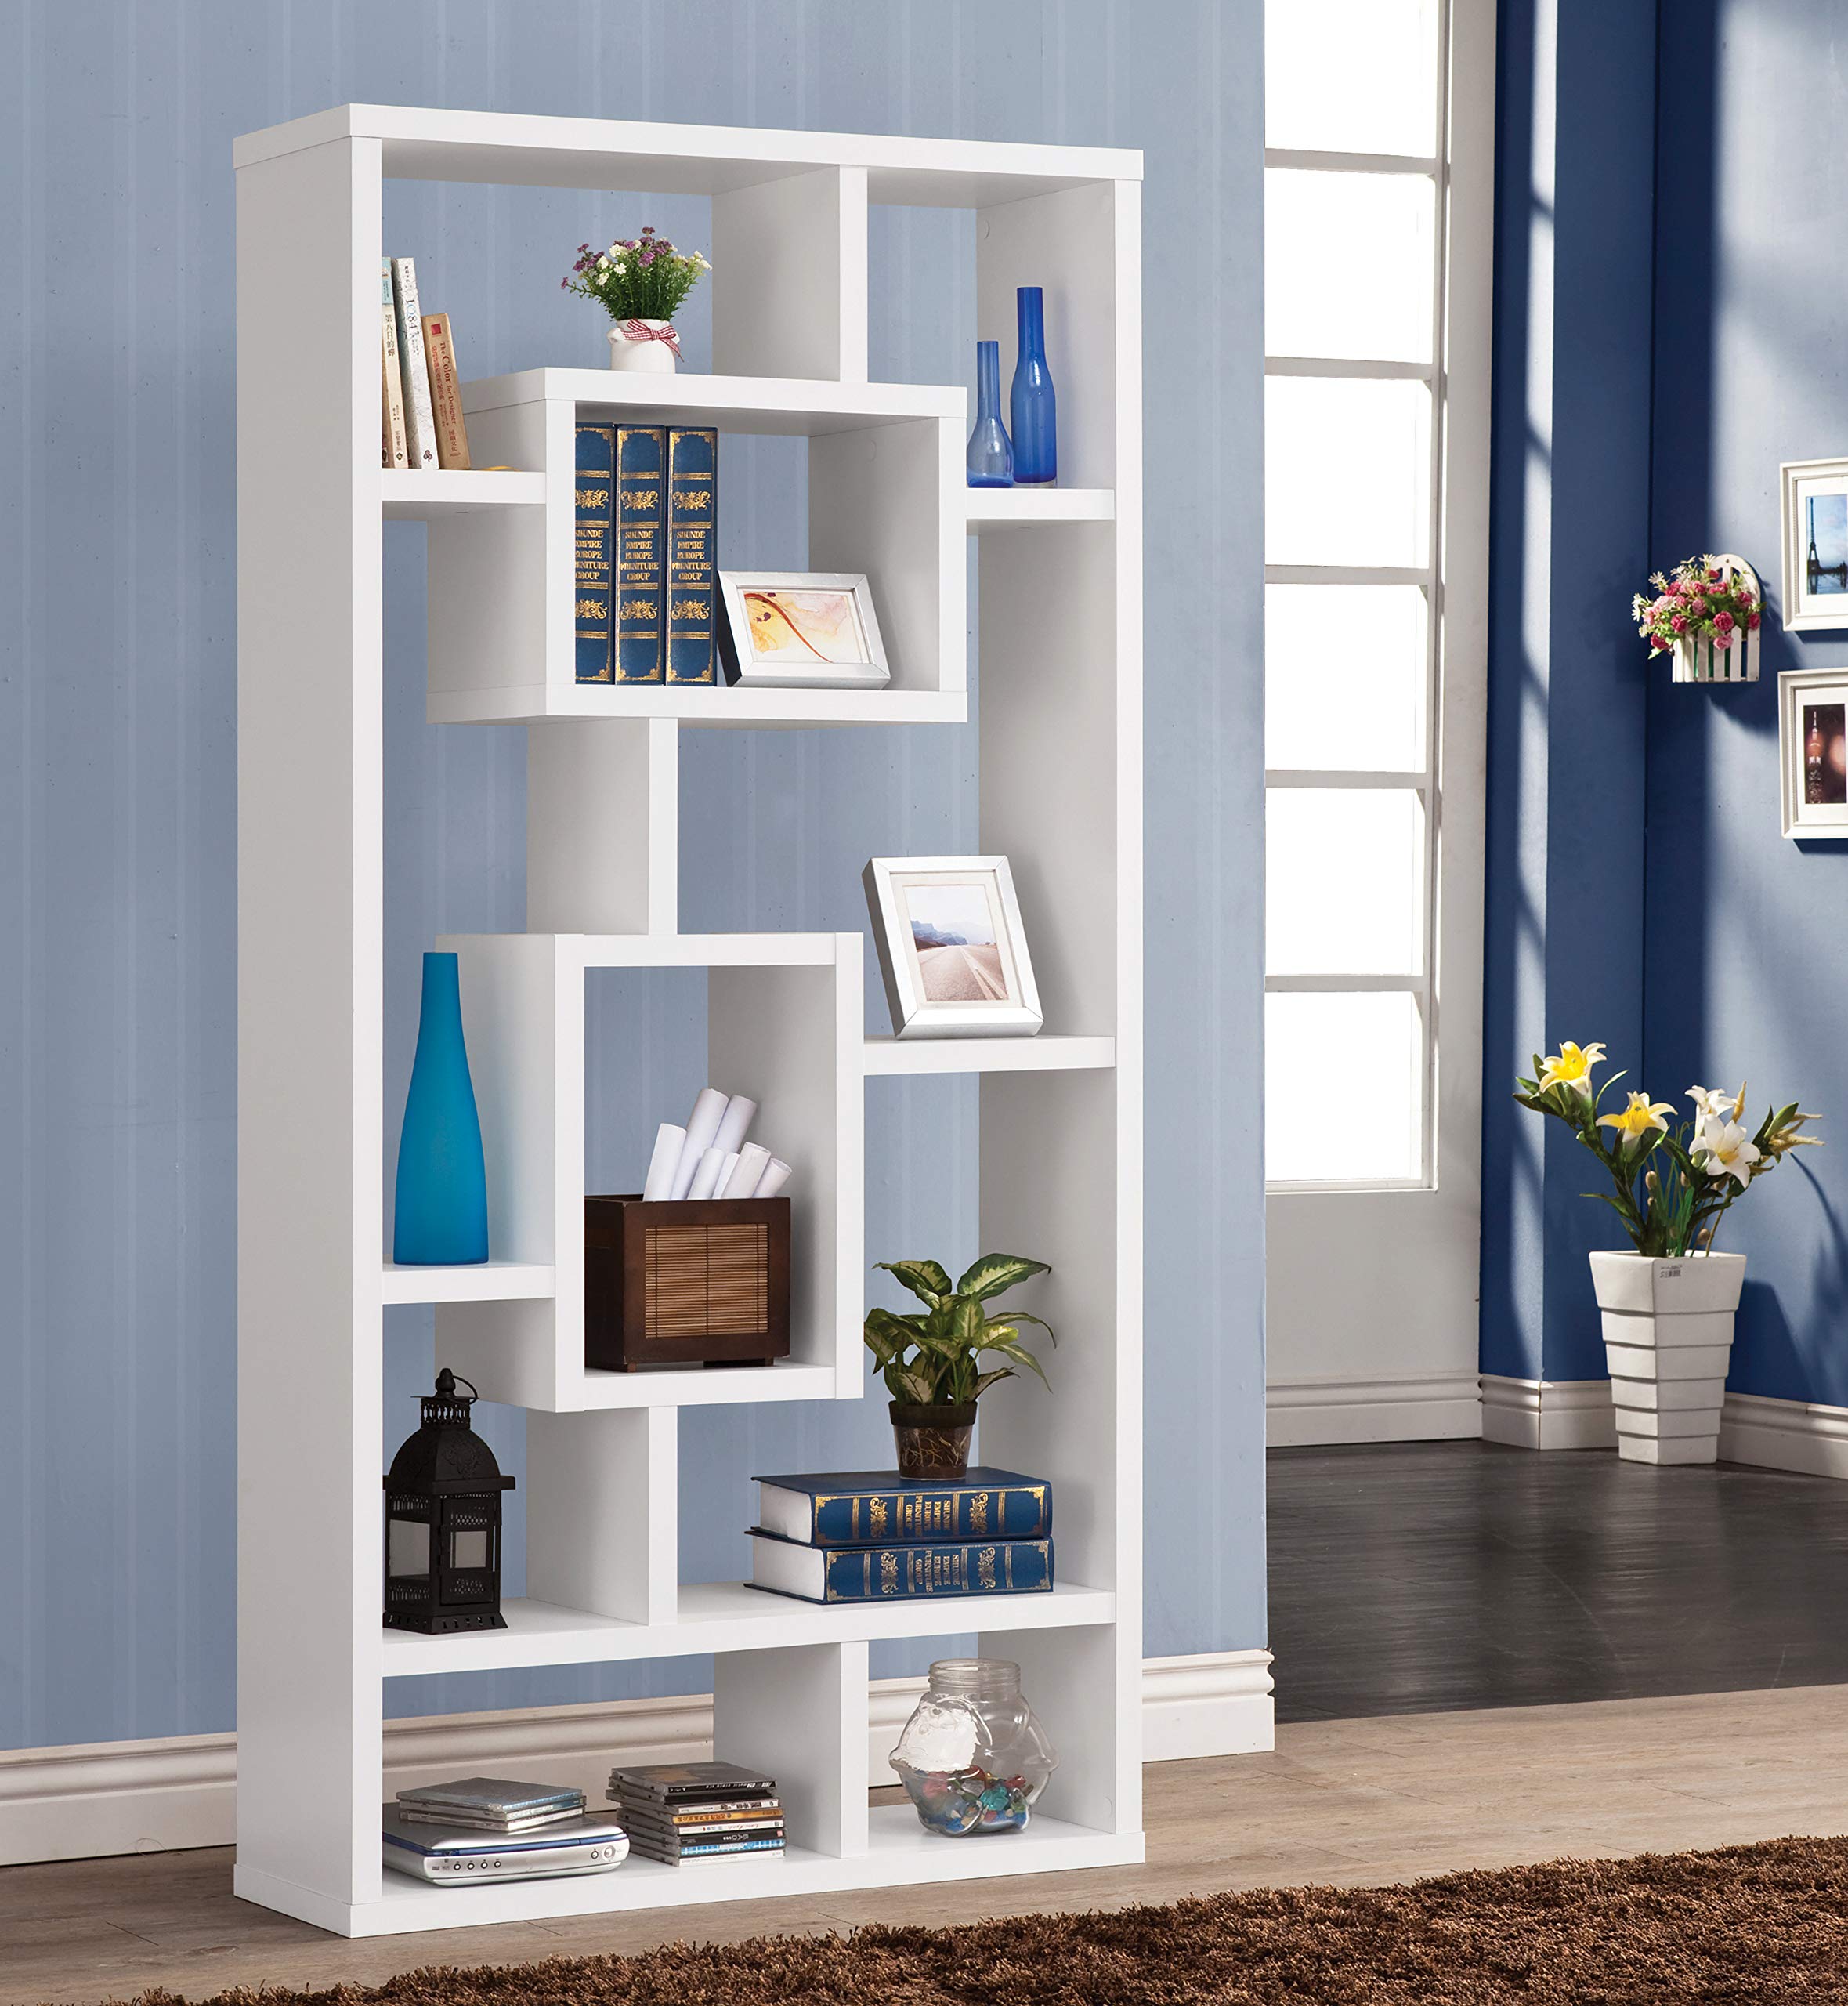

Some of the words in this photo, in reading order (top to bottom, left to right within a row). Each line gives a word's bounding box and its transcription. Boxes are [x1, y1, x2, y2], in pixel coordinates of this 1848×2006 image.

[441, 355, 452, 383] Color
[447, 394, 457, 424] Designer
[620, 562, 659, 570] FURNITURE
[671, 562, 711, 570] FURNITURE
[924, 1548, 934, 1593] FURNITURE
[933, 1555, 942, 1586] EUROPE
[942, 1555, 951, 1585] EMPIRE
[952, 1554, 960, 1585] SHUNDE
